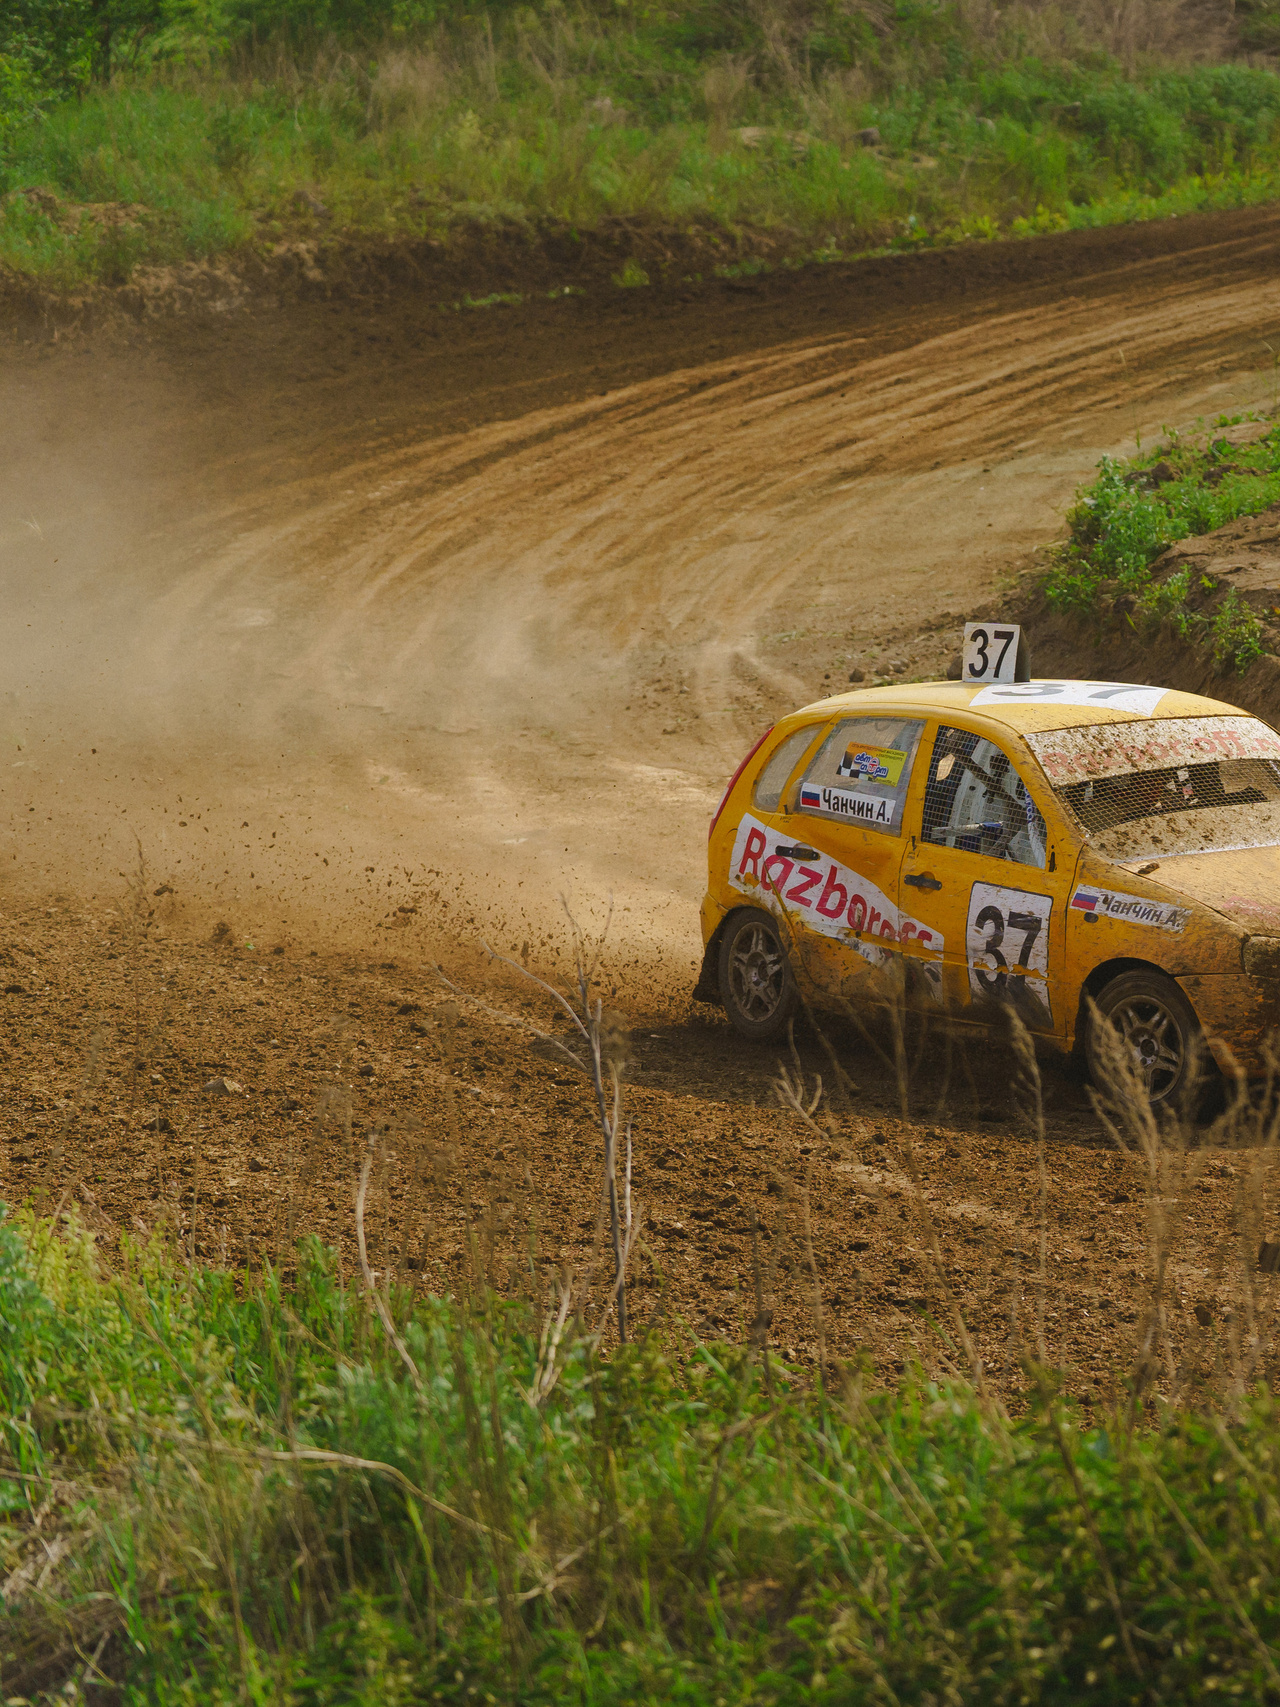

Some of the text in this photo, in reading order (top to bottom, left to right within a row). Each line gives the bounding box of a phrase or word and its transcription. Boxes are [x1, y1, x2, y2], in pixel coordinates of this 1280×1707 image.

[968, 628, 1015, 678] 37
[991, 683, 1158, 700] 37
[822, 788, 891, 823] Чанчин А.
[1100, 892, 1181, 928] Чанчин А.
[974, 905, 1043, 993] 37
